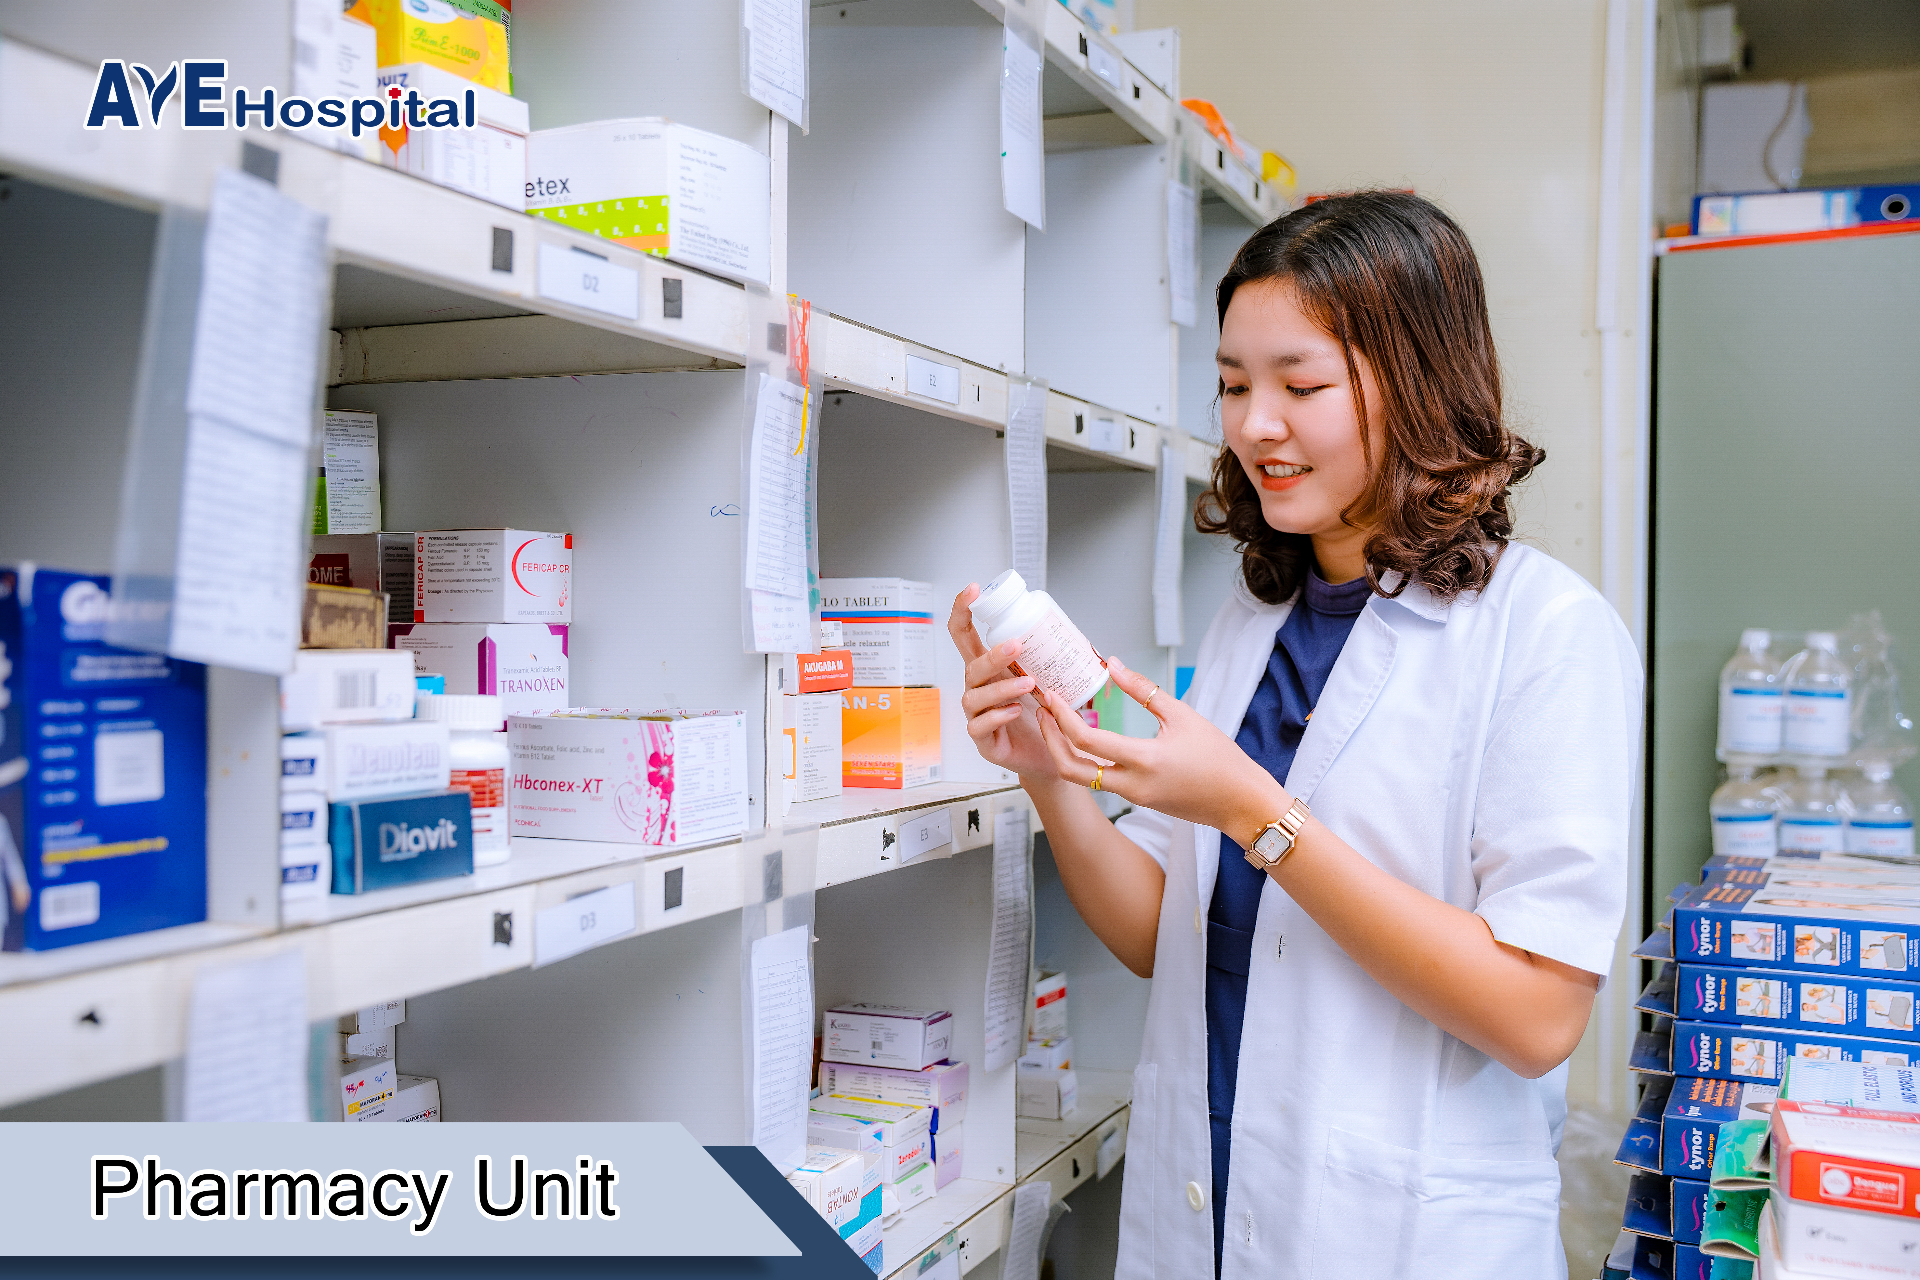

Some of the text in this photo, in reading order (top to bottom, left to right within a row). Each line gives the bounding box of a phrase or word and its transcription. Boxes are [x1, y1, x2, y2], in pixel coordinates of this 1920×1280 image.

[582, 273, 600, 293] D2
[929, 374, 937, 387] E2
[417, 536, 424, 553] CR
[522, 562, 570, 574] FERICAP CR
[843, 596, 889, 607] TABLET
[804, 659, 844, 674] AKUGABA M
[500, 676, 565, 693] TRANOXEN
[513, 773, 604, 794] Hbconex-XT
[379, 818, 458, 855] Diavit
[920, 828, 929, 842] E3
[580, 911, 596, 932] D3
[1697, 917, 1714, 956] tynor
[1702, 973, 1718, 1014] tynor
[1697, 1032, 1712, 1073] tynor
[1863, 1066, 1880, 1101] FULL ELASTIC
[1689, 1127, 1704, 1171] tynor
[1853, 1175, 1898, 1192] Dengue
